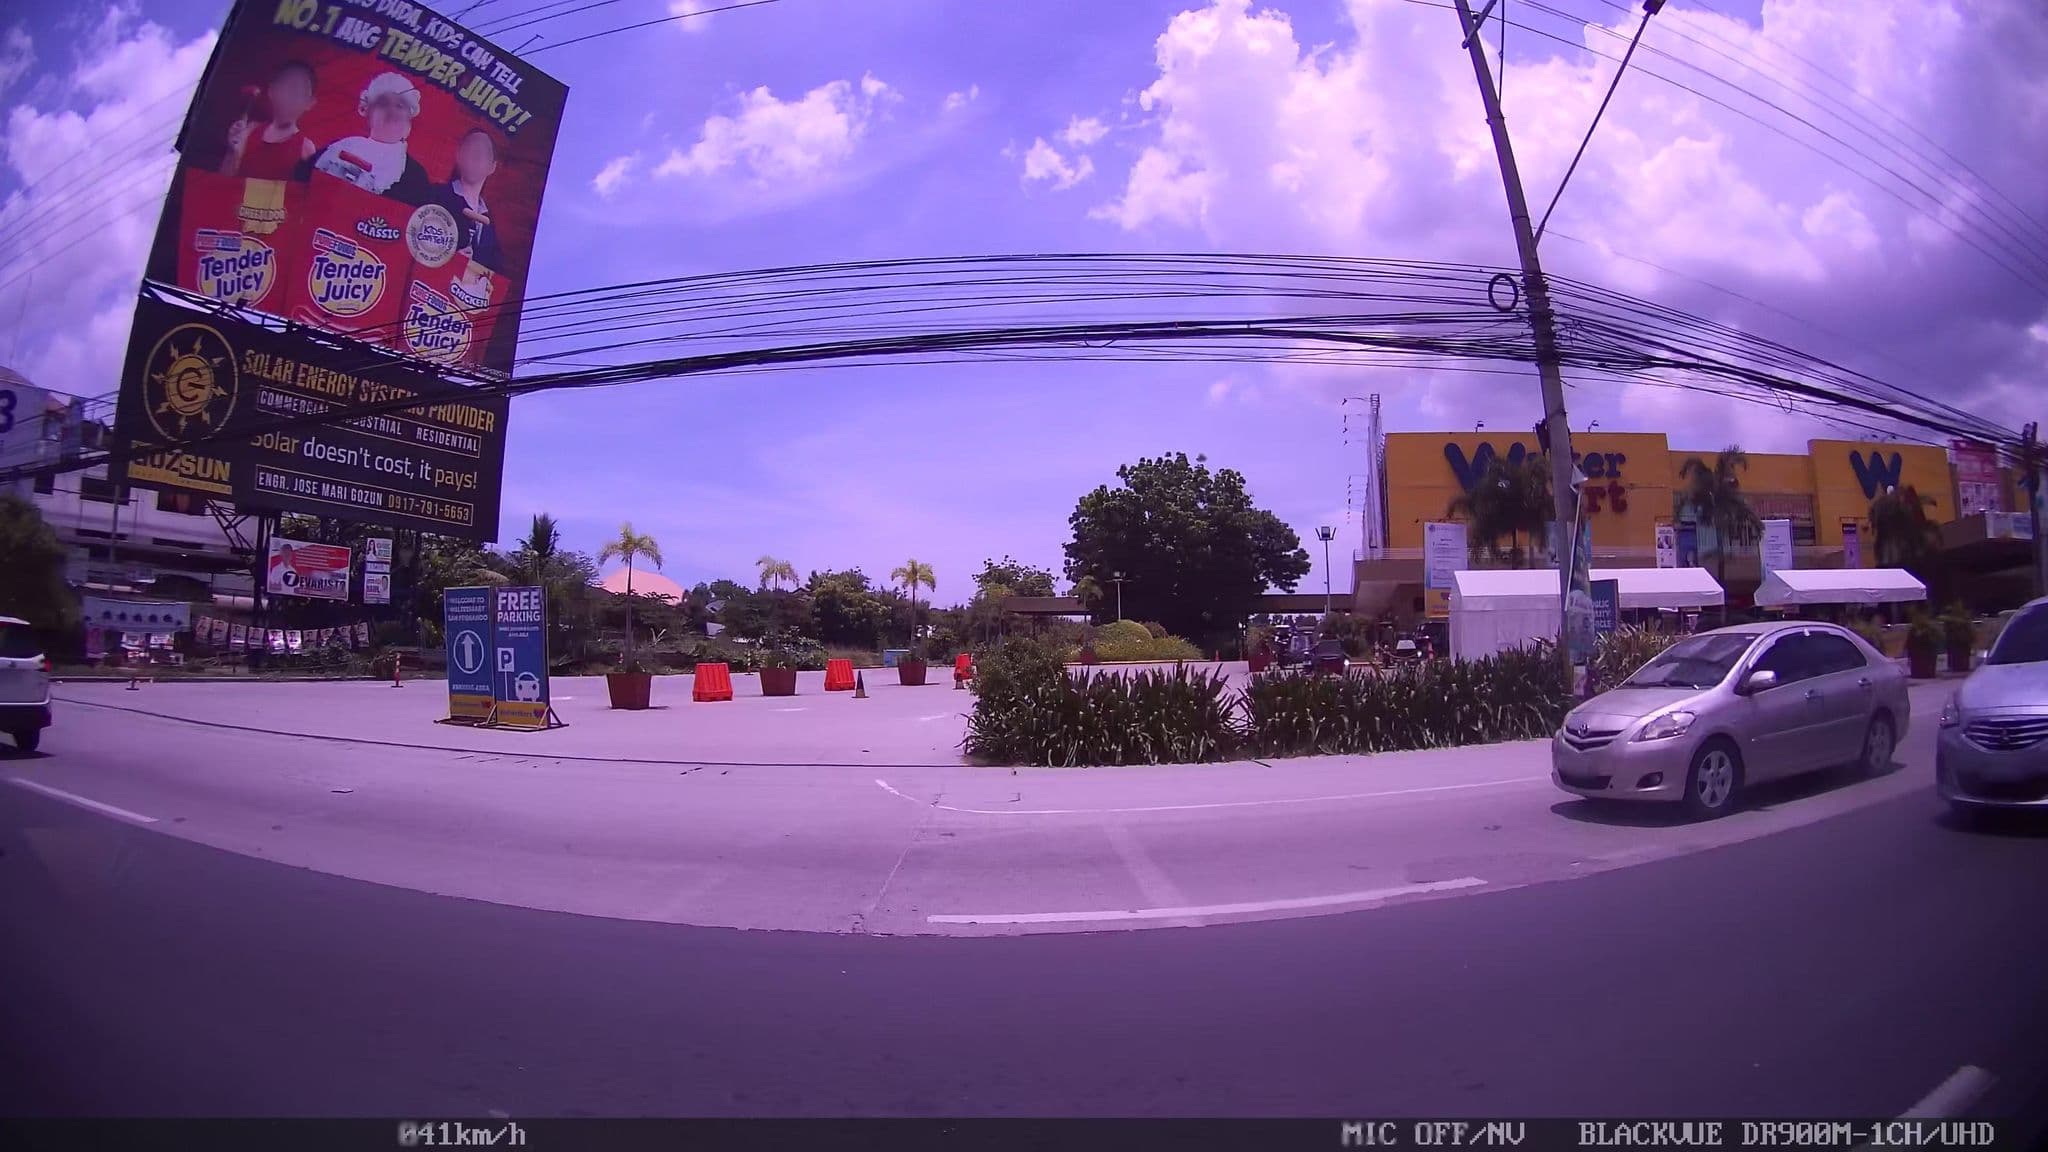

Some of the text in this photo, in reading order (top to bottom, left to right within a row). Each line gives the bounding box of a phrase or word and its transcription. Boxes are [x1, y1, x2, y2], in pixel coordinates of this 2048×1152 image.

[423, 17, 464, 49] KIDS
[461, 40, 495, 71] CAN
[491, 60, 523, 94] TELL
[334, 16, 382, 49] ANG
[380, 27, 466, 88] TENDER
[458, 75, 531, 132] JUICY!
[356, 221, 400, 240] CLASSIC
[202, 249, 272, 281] Tender
[315, 257, 385, 281] Tender
[215, 271, 265, 298] Juicy
[318, 279, 374, 303] Juicy
[451, 283, 488, 307] CHICKEN
[411, 306, 472, 335] Tender
[412, 329, 461, 352] Juicy
[243, 349, 295, 384] SOLAR
[295, 363, 358, 399] ENERGY
[428, 402, 495, 433] PROVIDER
[416, 427, 478, 452] RESIDENTIAL
[303, 436, 371, 469] doesn't
[374, 455, 415, 480] cost,
[420, 459, 432, 481] it
[434, 468, 478, 492] pays!
[1849, 450, 1902, 500] W
[258, 471, 469, 521] ENGR. JOSE MARI GOZUN 0917-791-5653
[286, 573, 297, 586] 7
[498, 591, 540, 610] FREE
[497, 611, 540, 622] PARKING
